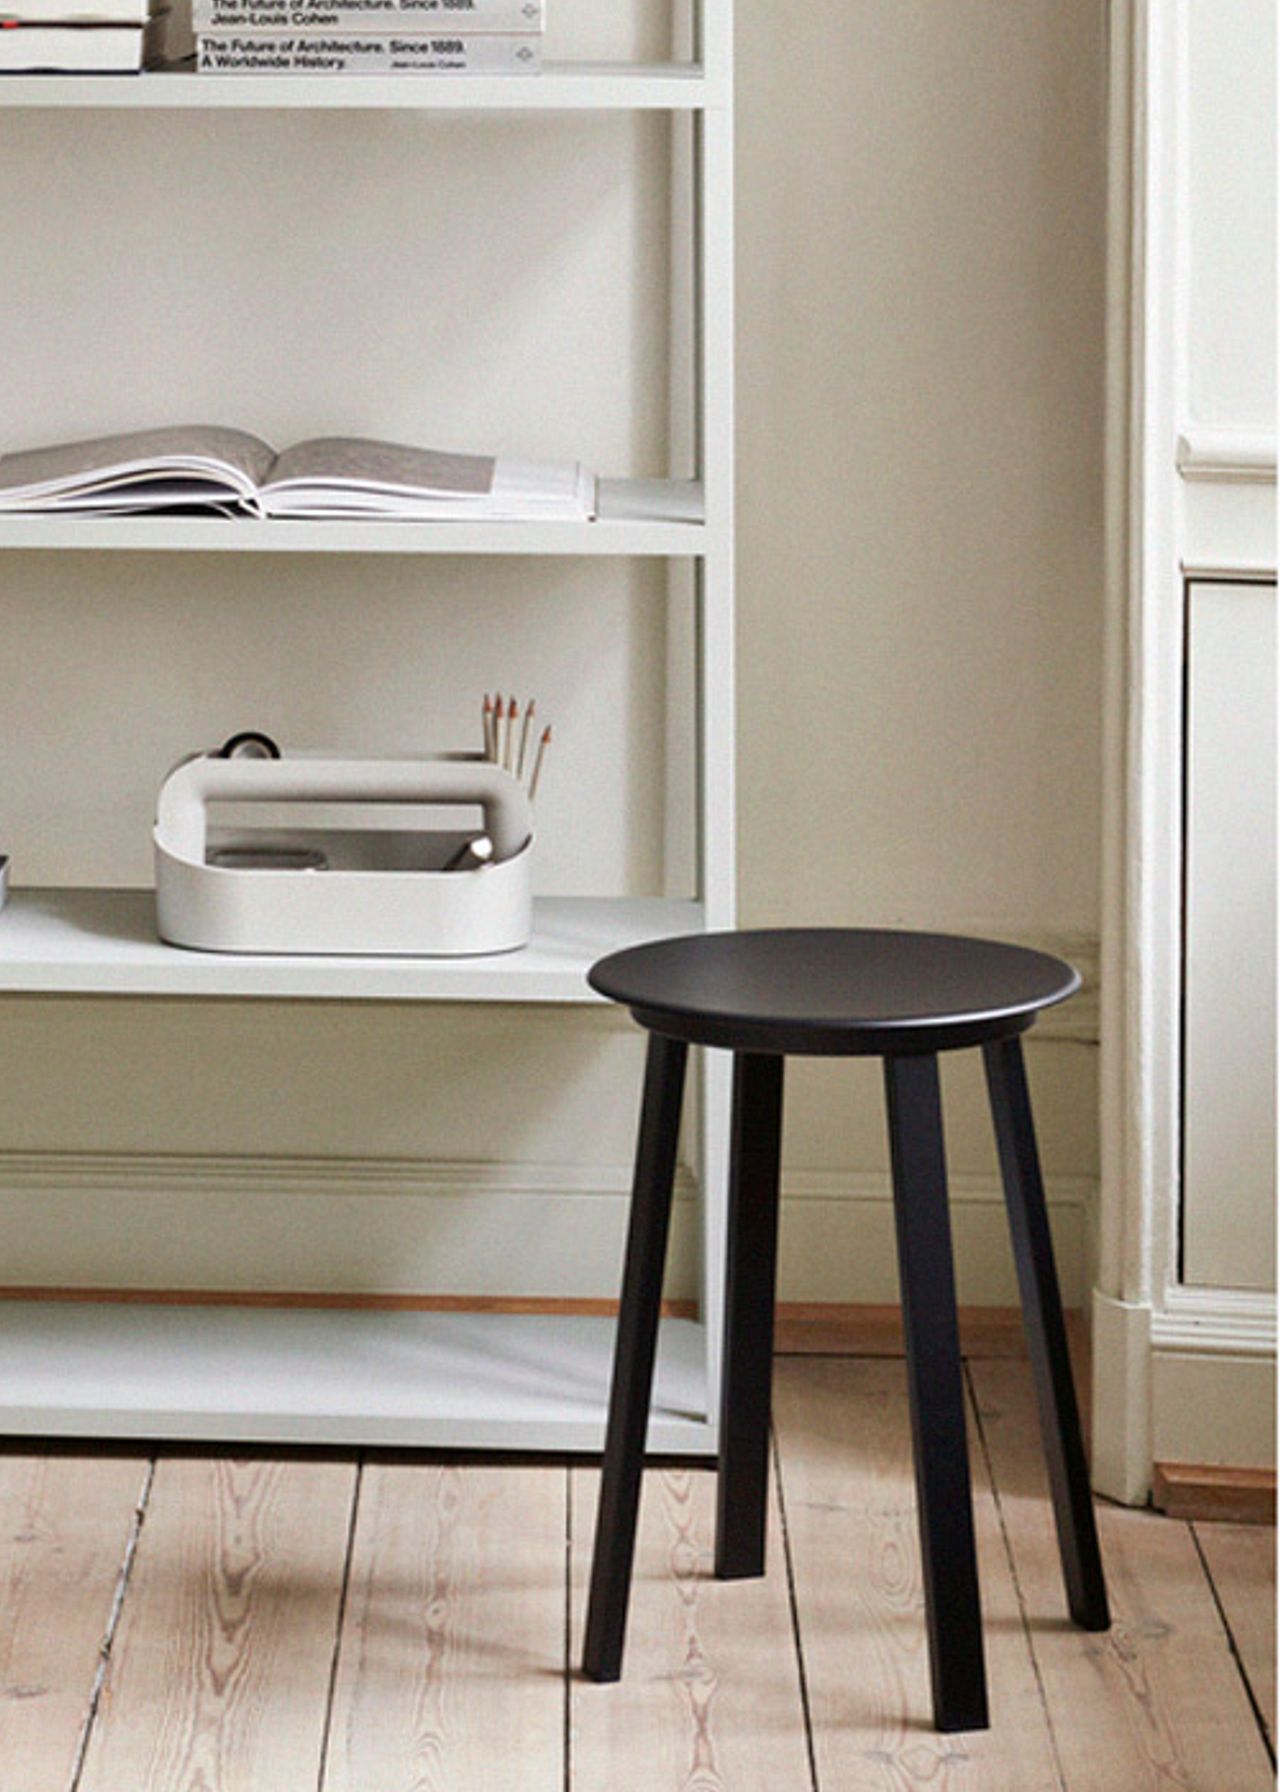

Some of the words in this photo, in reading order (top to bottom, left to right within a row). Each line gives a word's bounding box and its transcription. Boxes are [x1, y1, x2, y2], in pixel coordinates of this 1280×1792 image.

[211, 13, 288, 26] Jean-Louis
[292, 13, 338, 25] Cohen
[201, 40, 227, 52] The
[232, 40, 276, 52] Future
[279, 40, 295, 52] of
[297, 40, 386, 53] Architecture.
[389, 40, 429, 53] Since
[201, 56, 212, 67] A
[216, 56, 290, 68] Worldwide
